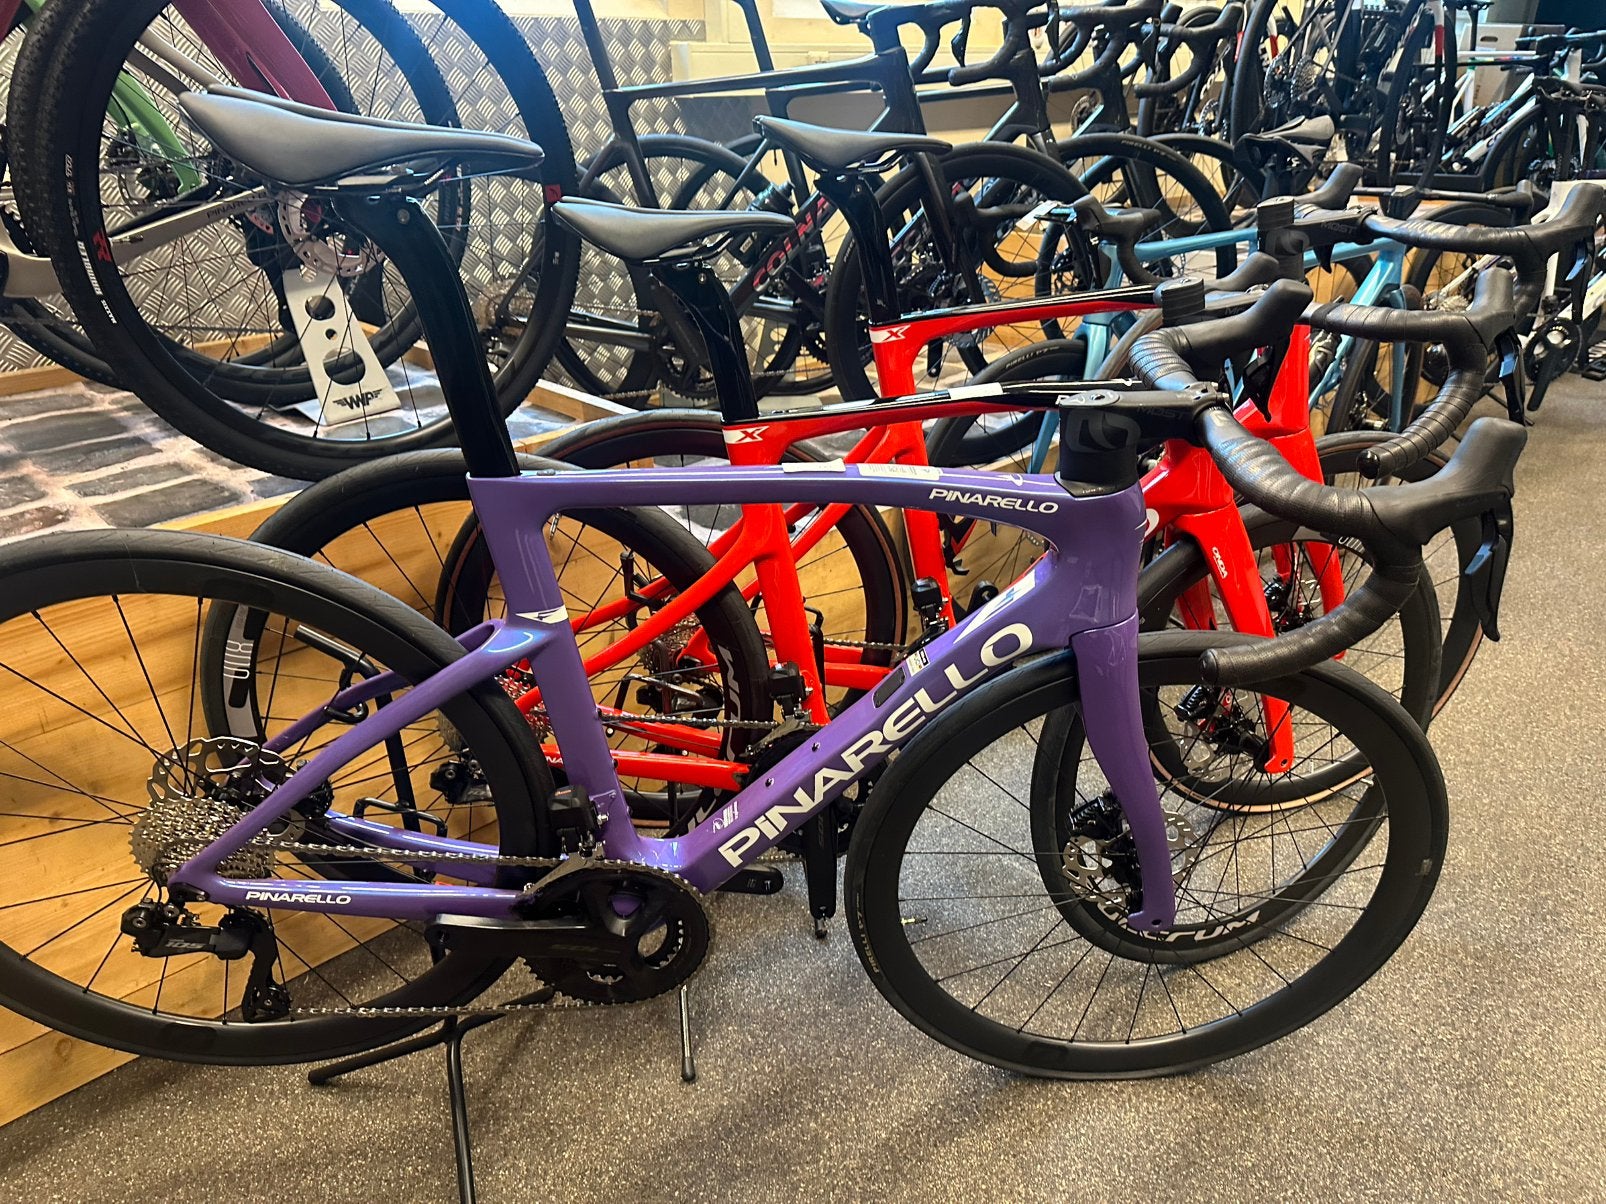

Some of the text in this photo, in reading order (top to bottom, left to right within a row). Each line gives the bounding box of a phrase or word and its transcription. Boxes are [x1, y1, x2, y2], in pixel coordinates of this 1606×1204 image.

[77, 240, 103, 296] RAMBLER
[101, 299, 118, 324] MAXXIS
[1136, 406, 1189, 420] MOST
[929, 488, 1059, 514] PINARELLO
[718, 623, 1034, 868] PINARELLO
[245, 890, 352, 906] PINARELLO
